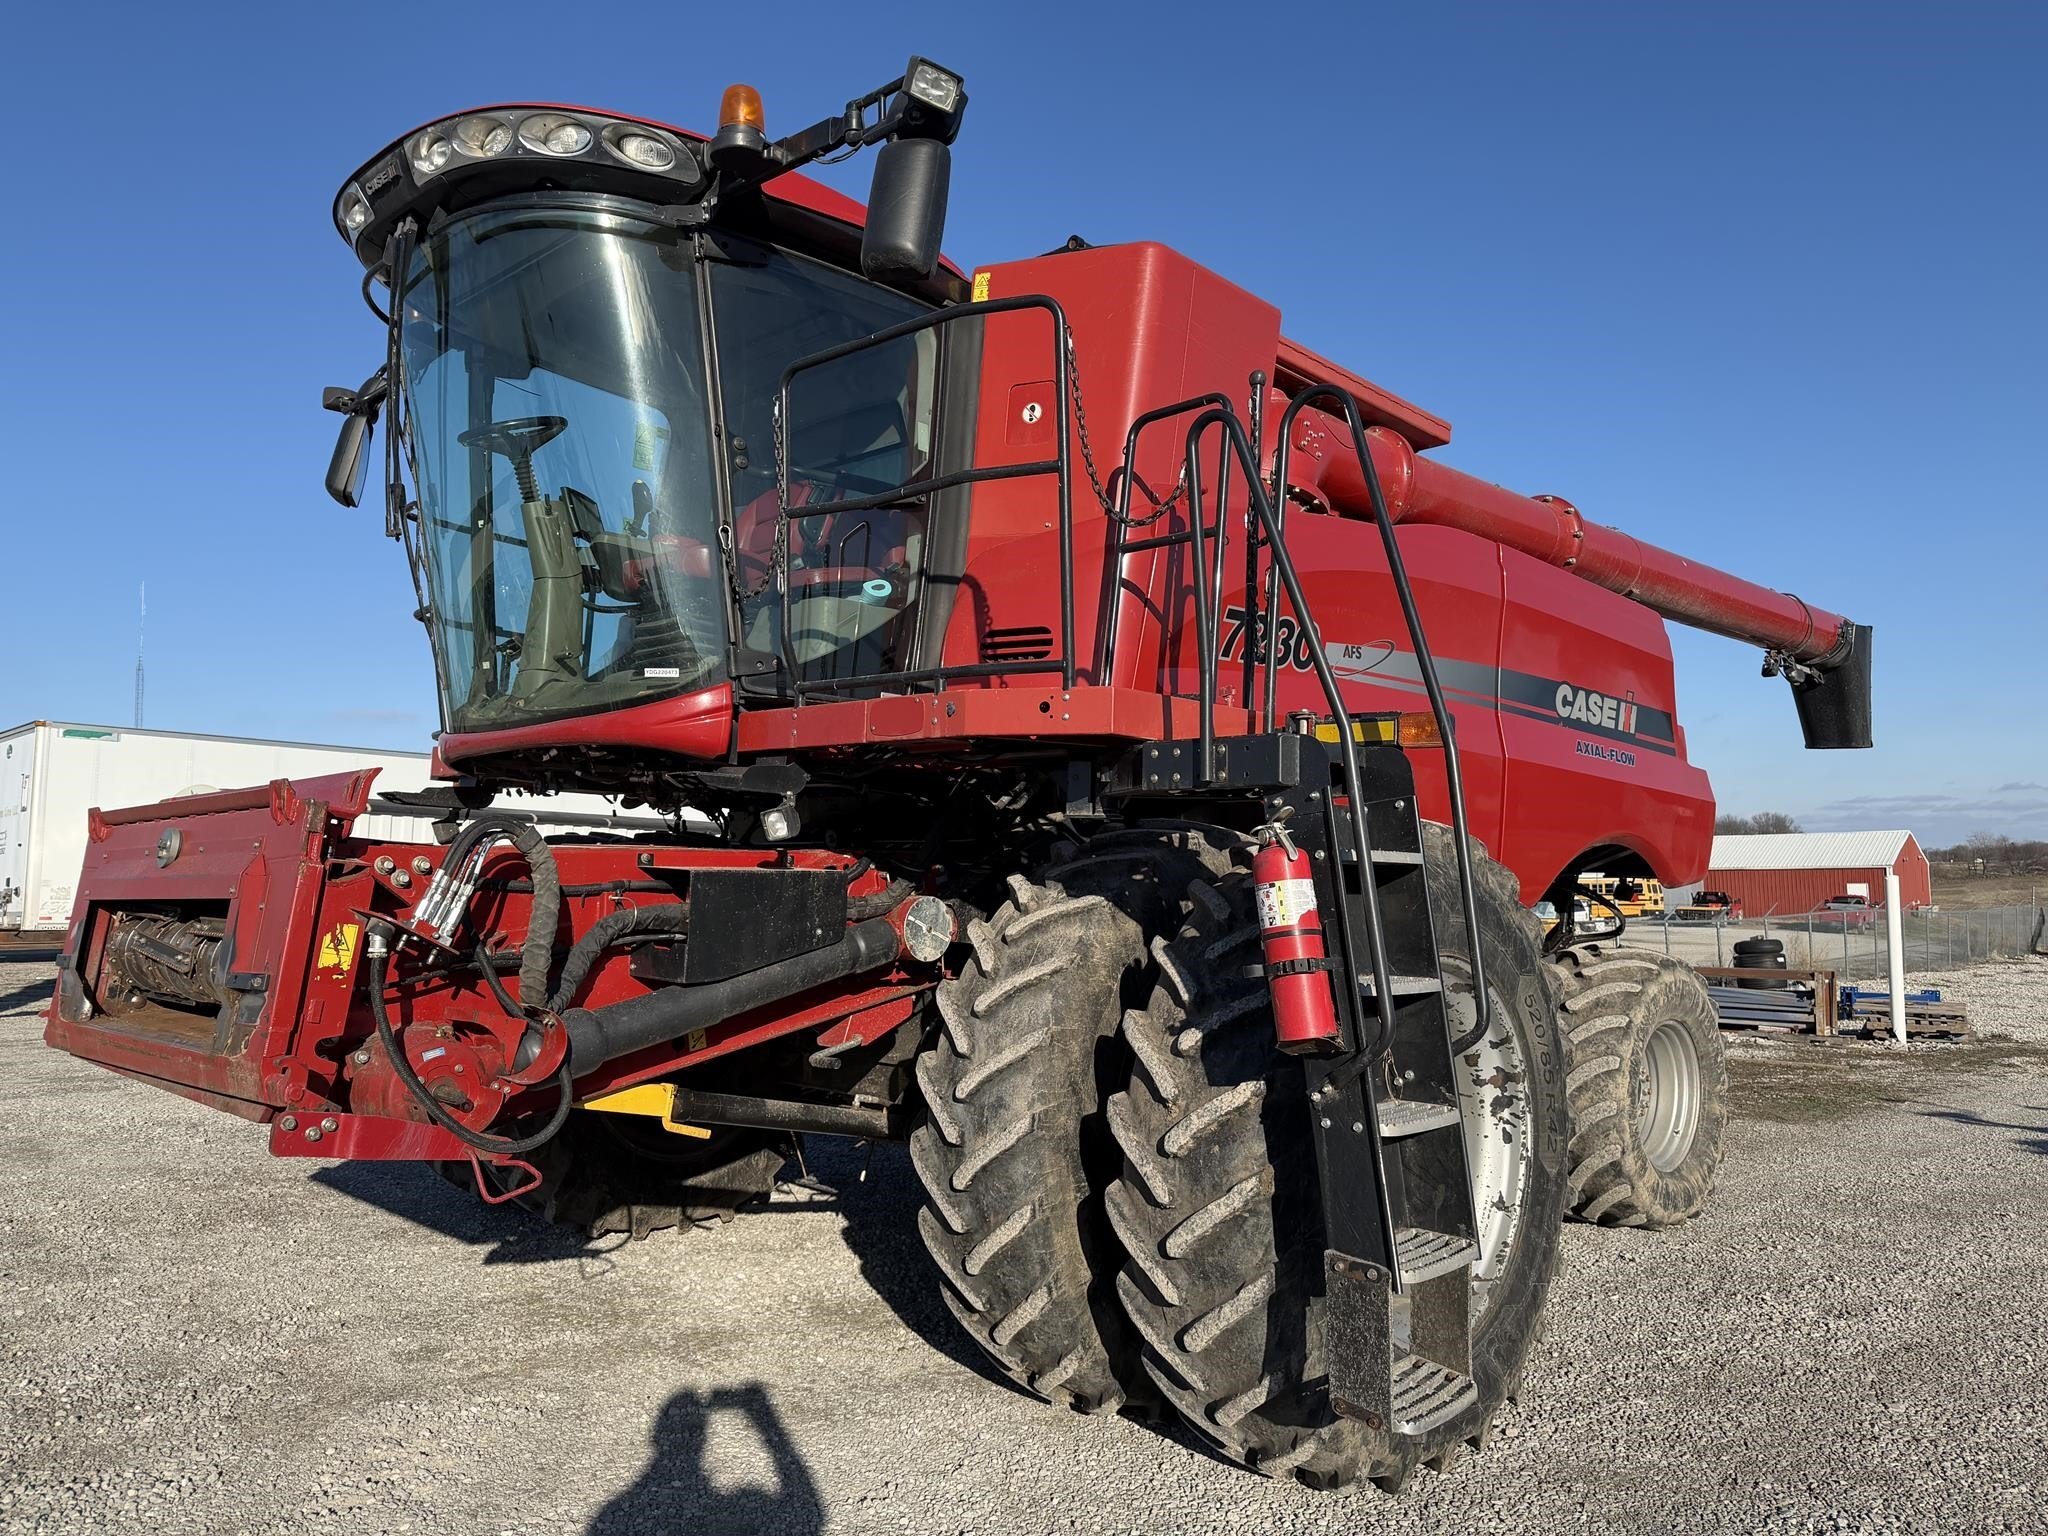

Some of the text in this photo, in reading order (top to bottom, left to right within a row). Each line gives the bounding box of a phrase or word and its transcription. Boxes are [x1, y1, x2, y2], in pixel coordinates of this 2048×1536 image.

[1343, 644, 1362, 660] AFS
[1555, 683, 1618, 729] CASE
[1575, 739, 1636, 767] AXIAL-FLOW
[1524, 993, 1555, 1085] 520/85
